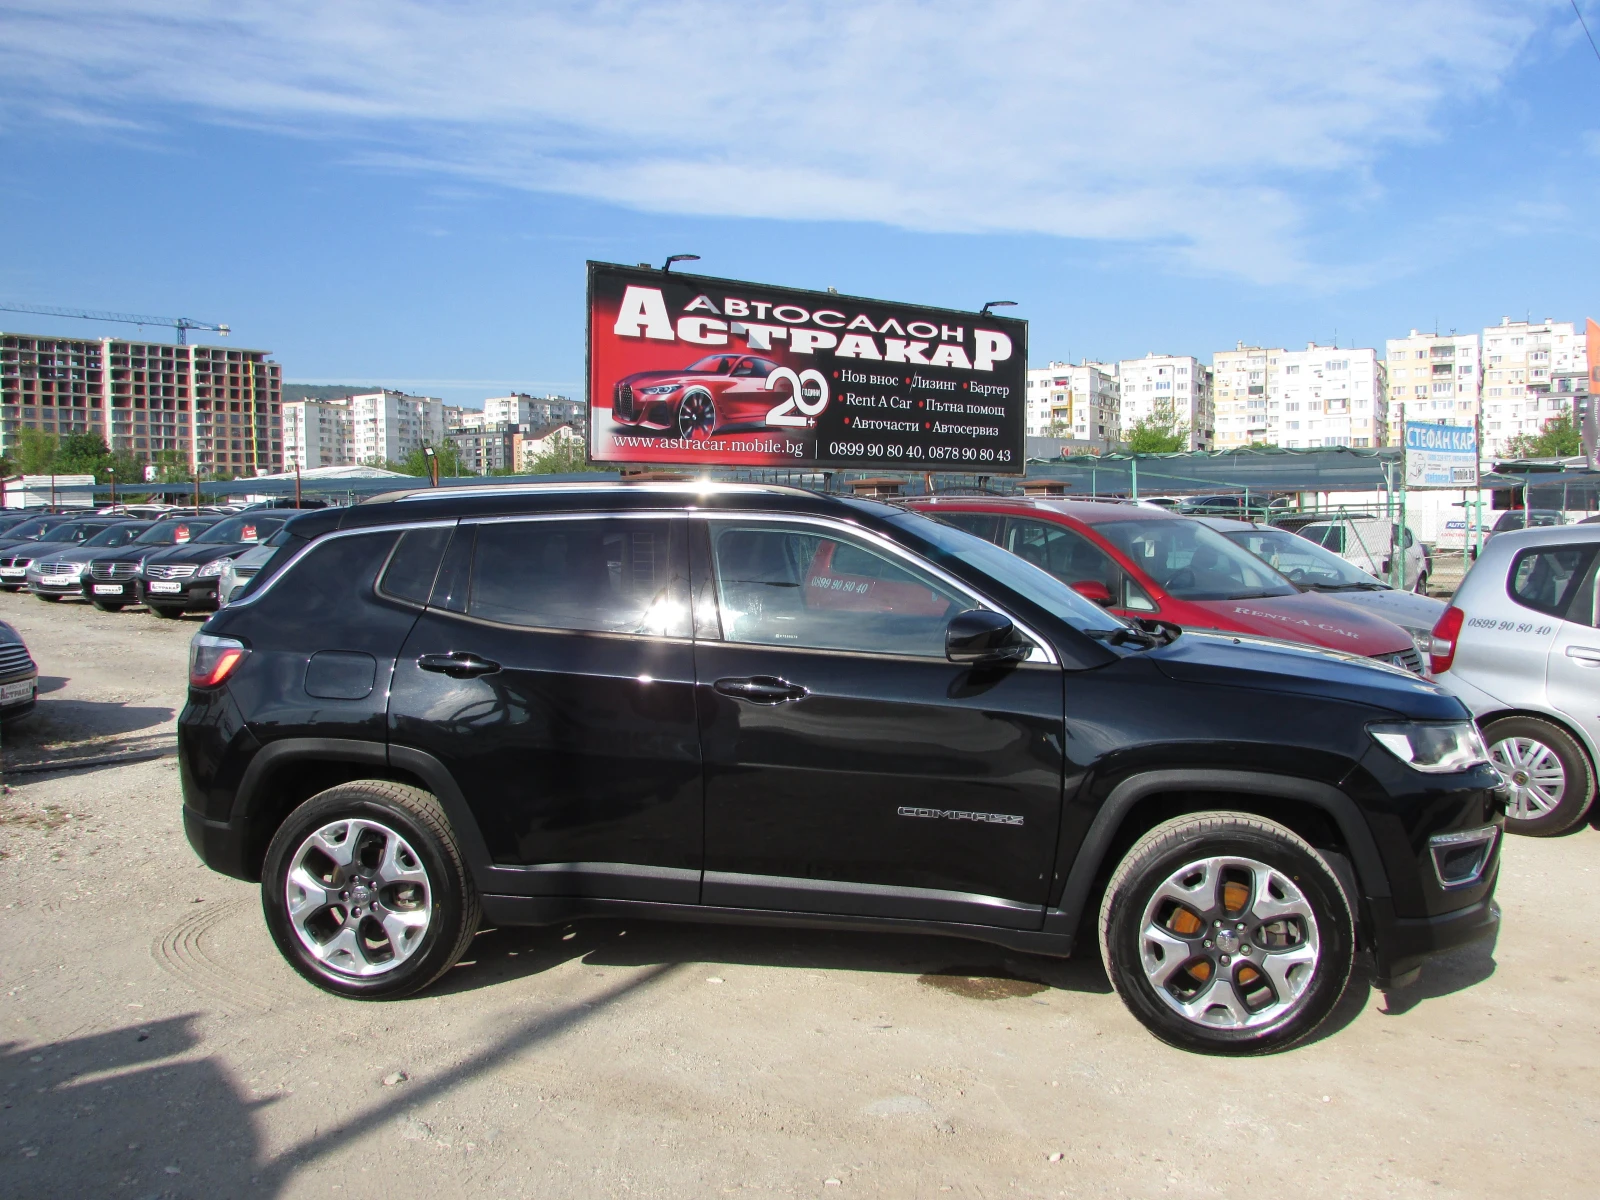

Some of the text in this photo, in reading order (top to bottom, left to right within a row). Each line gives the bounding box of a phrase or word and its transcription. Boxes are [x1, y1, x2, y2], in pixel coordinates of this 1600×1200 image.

[683, 295, 964, 342] АВТОСАЛОН
[613, 285, 1012, 371] АСТРАКАР
[841, 369, 899, 386] Нов внос
[913, 375, 957, 391] Лизинг
[969, 381, 1010, 398] Бартер
[846, 393, 912, 409] Rent A Car
[926, 399, 1005, 417] Пътна помощ
[852, 416, 920, 432] Авточасти
[932, 421, 999, 438] Автосервиз
[613, 435, 804, 457] www.astracar.mobile.bg
[1407, 427, 1475, 450] СТЕФАН КАР
[829, 442, 1011, 462] 0899 90 80 40, 0878 90 80 43
[811, 576, 868, 594] 0899 90 80 40
[1233, 606, 1359, 639] RENT-A-CAR
[1467, 617, 1551, 635] 0899 90 80 40
[897, 806, 1024, 825] COMPASS
